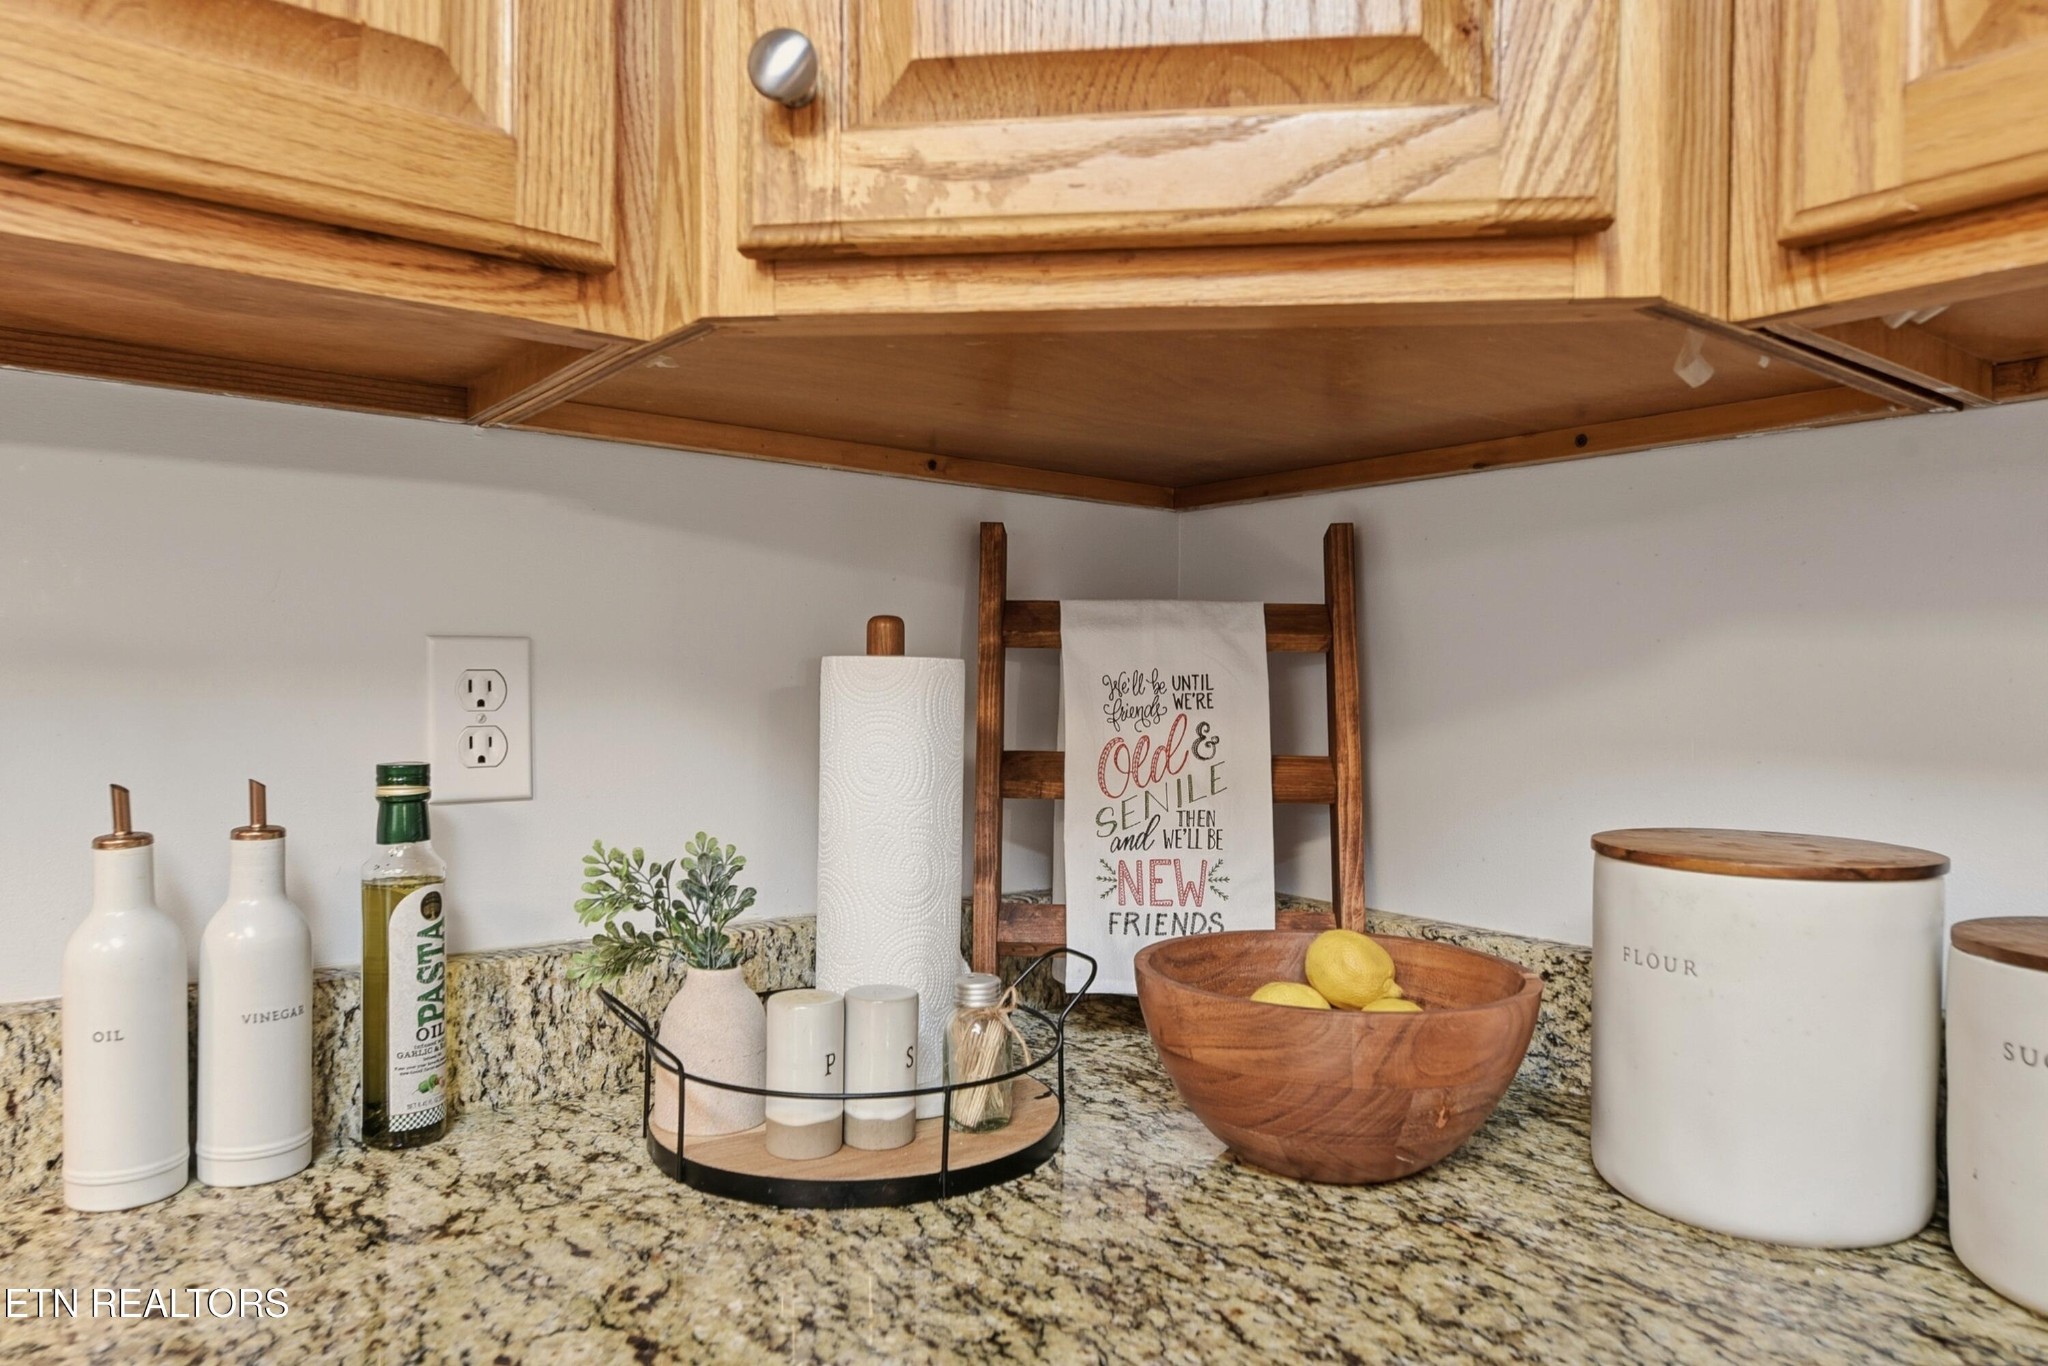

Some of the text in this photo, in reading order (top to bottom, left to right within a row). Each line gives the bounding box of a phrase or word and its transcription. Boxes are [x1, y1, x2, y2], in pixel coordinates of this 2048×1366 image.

[1102, 668, 1167, 701] We'll be
[1172, 673, 1214, 691] UNTIL
[1103, 694, 1168, 733] friends
[1172, 692, 1214, 710] WE'RE
[1097, 713, 1220, 799] Old &
[1095, 760, 1228, 838] SENILE
[1176, 809, 1216, 828] THEN
[1110, 814, 1161, 853] and
[1163, 829, 1223, 850] WE'LL BE
[1117, 858, 1208, 907] NEW
[1108, 911, 1225, 936] FRIENDS
[416, 916, 445, 1027] PASTA
[1622, 946, 1698, 978] FLOUR
[92, 1030, 125, 1043] OIL
[416, 1022, 445, 1042] OIL
[825, 1053, 836, 1077] P
[906, 1046, 914, 1069] S
